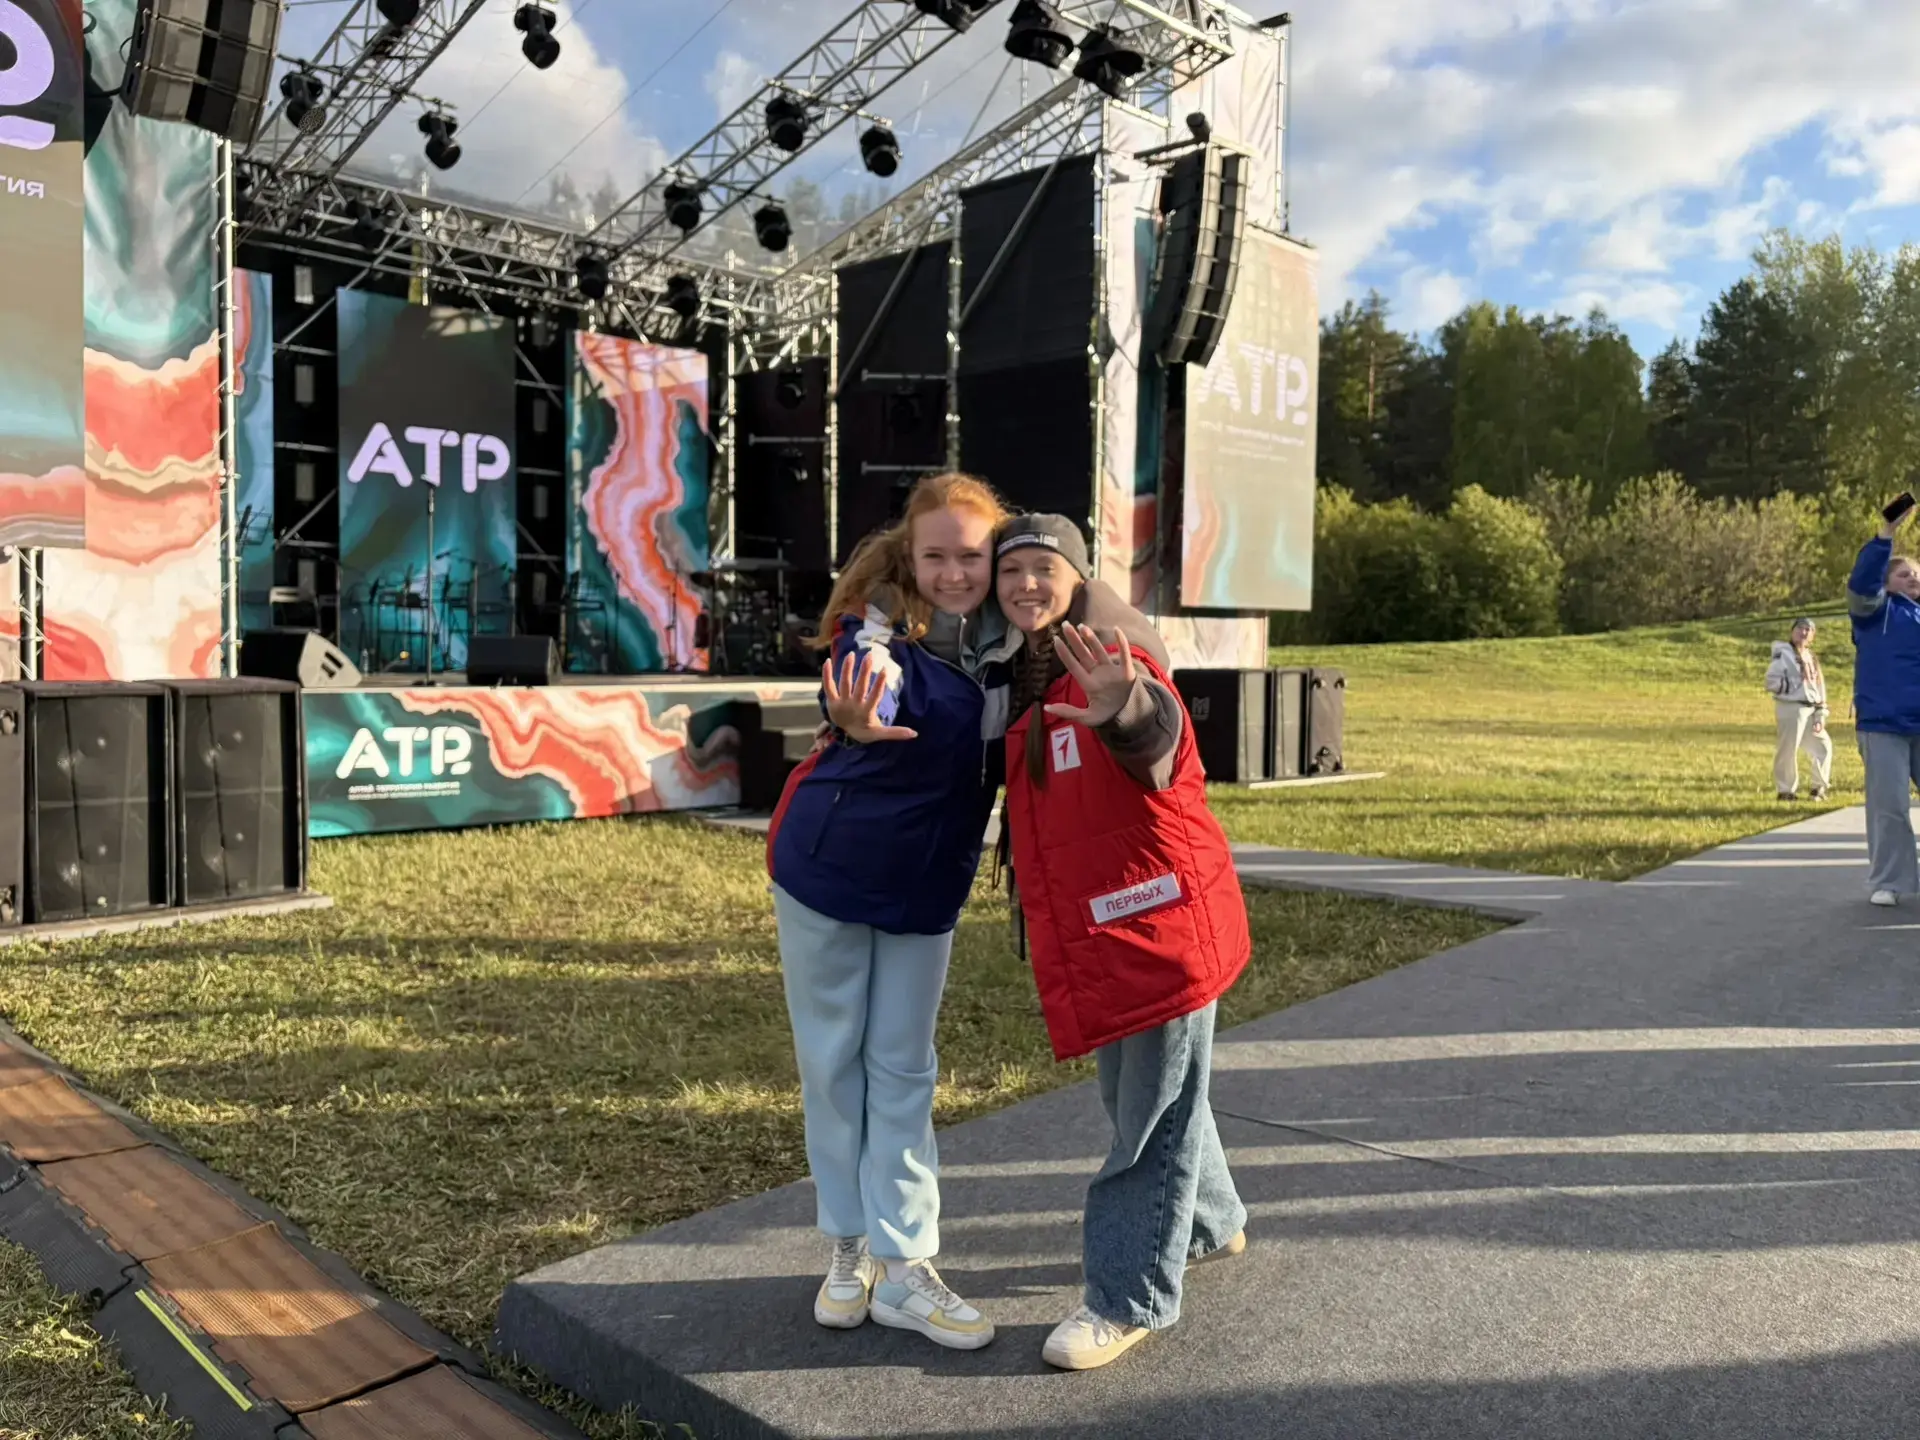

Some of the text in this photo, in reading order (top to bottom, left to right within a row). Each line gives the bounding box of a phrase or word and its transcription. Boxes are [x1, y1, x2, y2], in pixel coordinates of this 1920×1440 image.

[347, 422, 511, 494] АТР
[335, 726, 472, 779] АТР
[1105, 884, 1164, 913] ПЕРВЫХ
